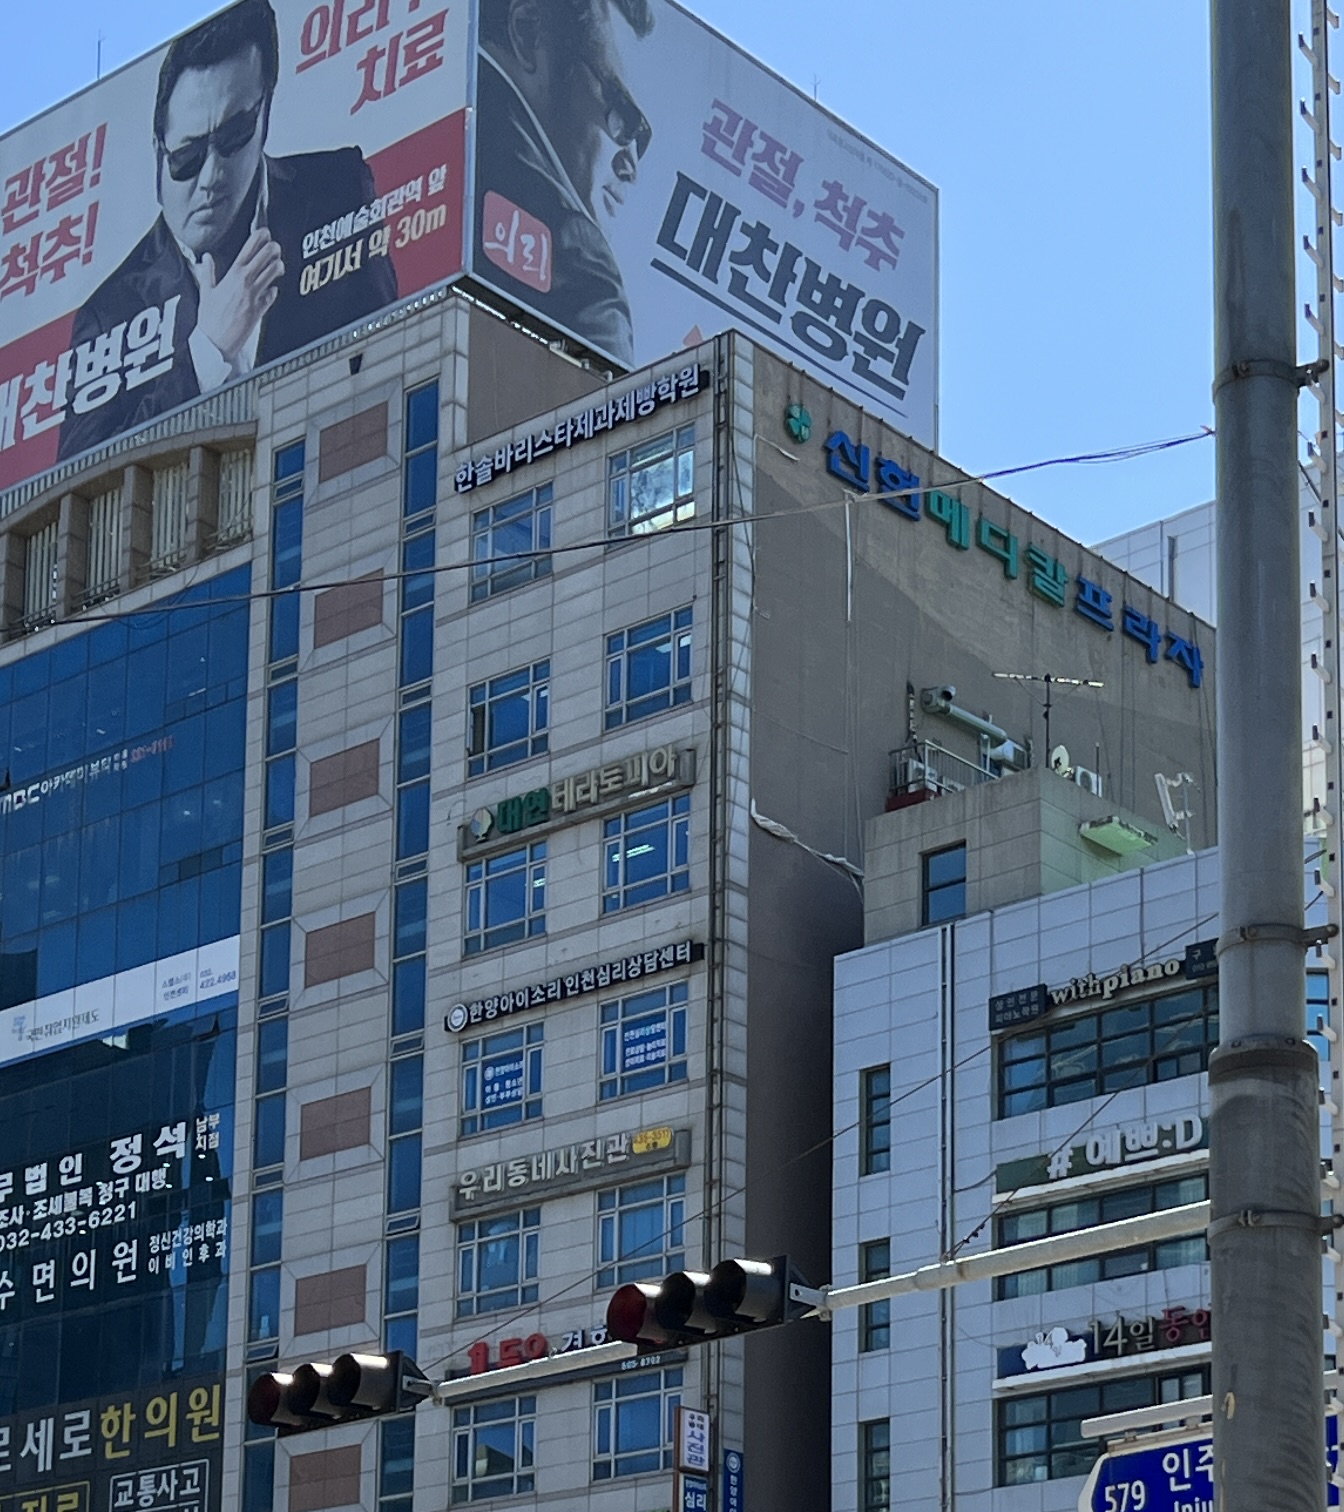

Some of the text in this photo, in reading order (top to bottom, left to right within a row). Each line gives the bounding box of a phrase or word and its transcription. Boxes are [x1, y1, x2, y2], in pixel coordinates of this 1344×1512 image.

[296, 0, 420, 74] 의리
[350, 8, 449, 116] 치료
[0, 121, 108, 234] 관절!
[302, 164, 447, 259] 인천예술회관역 앞
[299, 203, 447, 297] 여기서 약 30m
[483, 209, 548, 281] 의리
[814, 174, 907, 271] 척추
[656, 170, 926, 401] 대찬병원
[468, 941, 691, 1023] 한양아이소리 인천심리상담센터
[110, 1121, 186, 1173] 정석
[459, 1133, 629, 1200] 우리동네사진관
[1088, 1314, 1157, 1356] 14일
[114, 1467, 201, 1508] 교통사고
[685, 1492, 706, 1511] 심리
